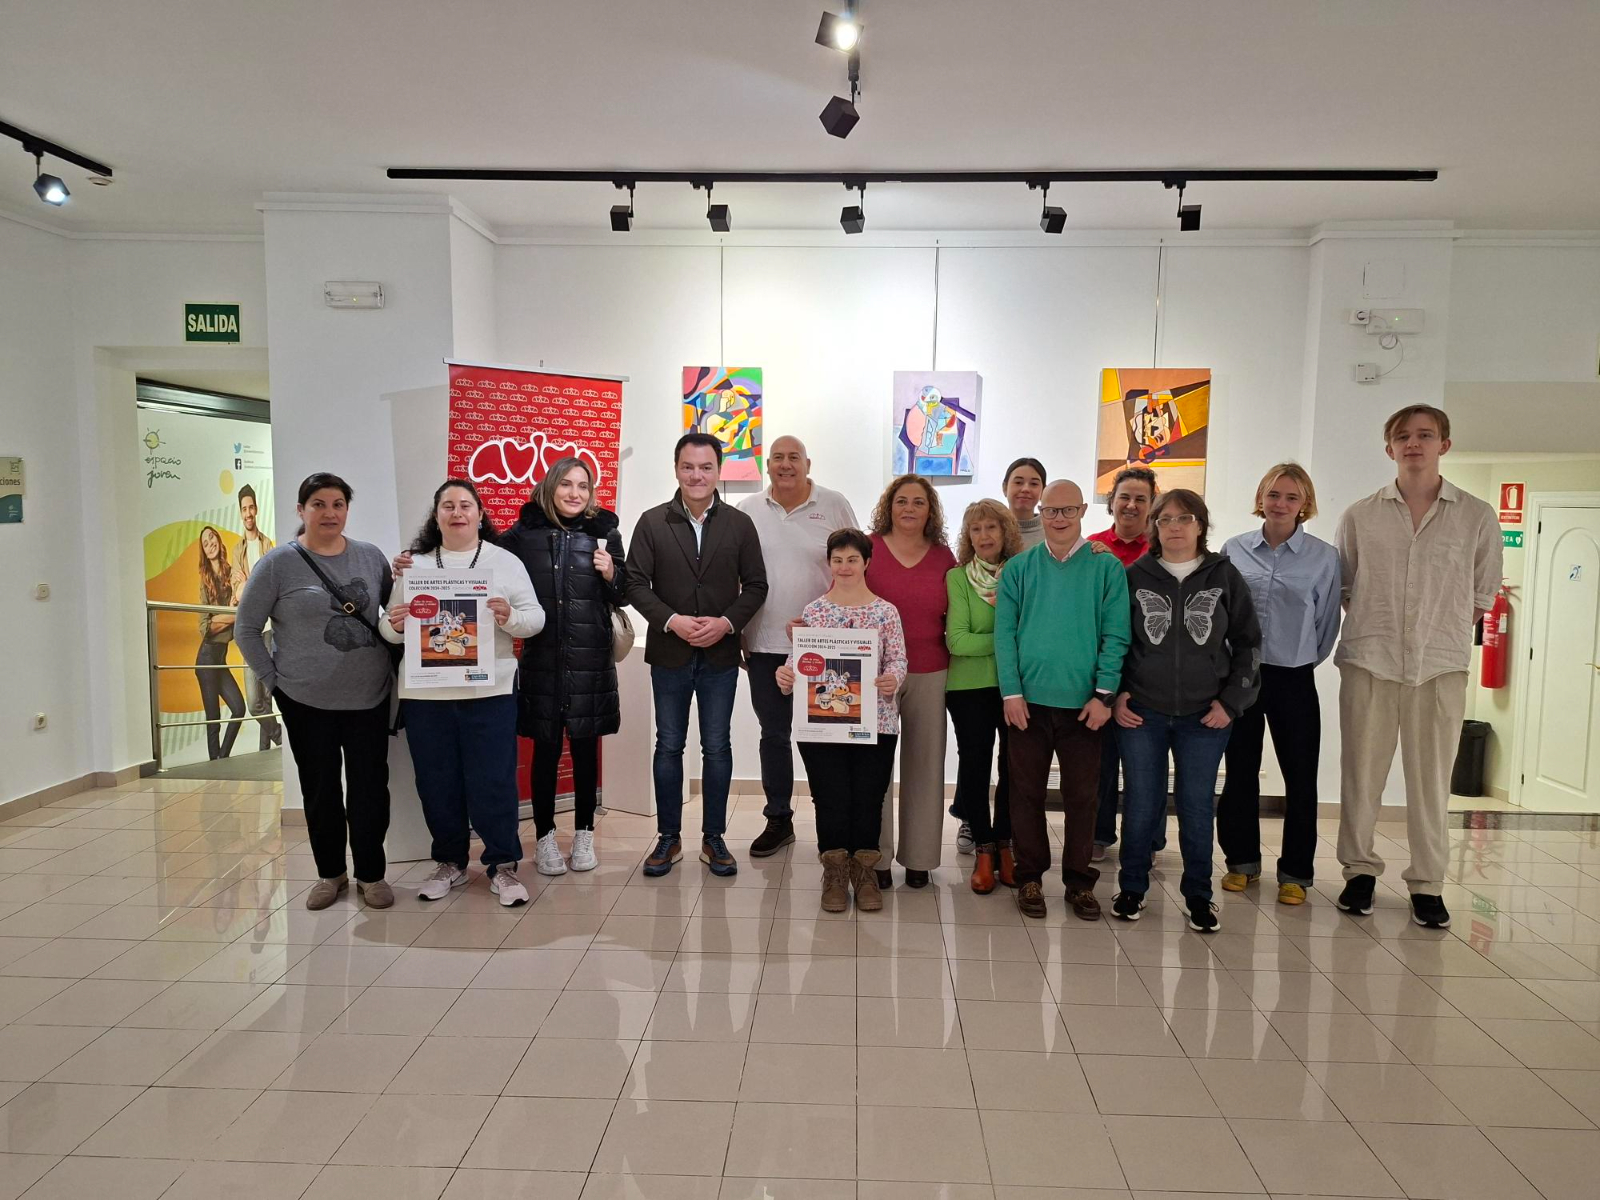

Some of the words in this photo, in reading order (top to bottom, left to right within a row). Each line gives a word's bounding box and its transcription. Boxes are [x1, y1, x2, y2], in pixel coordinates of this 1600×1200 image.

[187, 313, 238, 333] SALIDA
[145, 456, 181, 469] espacio
[147, 467, 181, 488] joven
